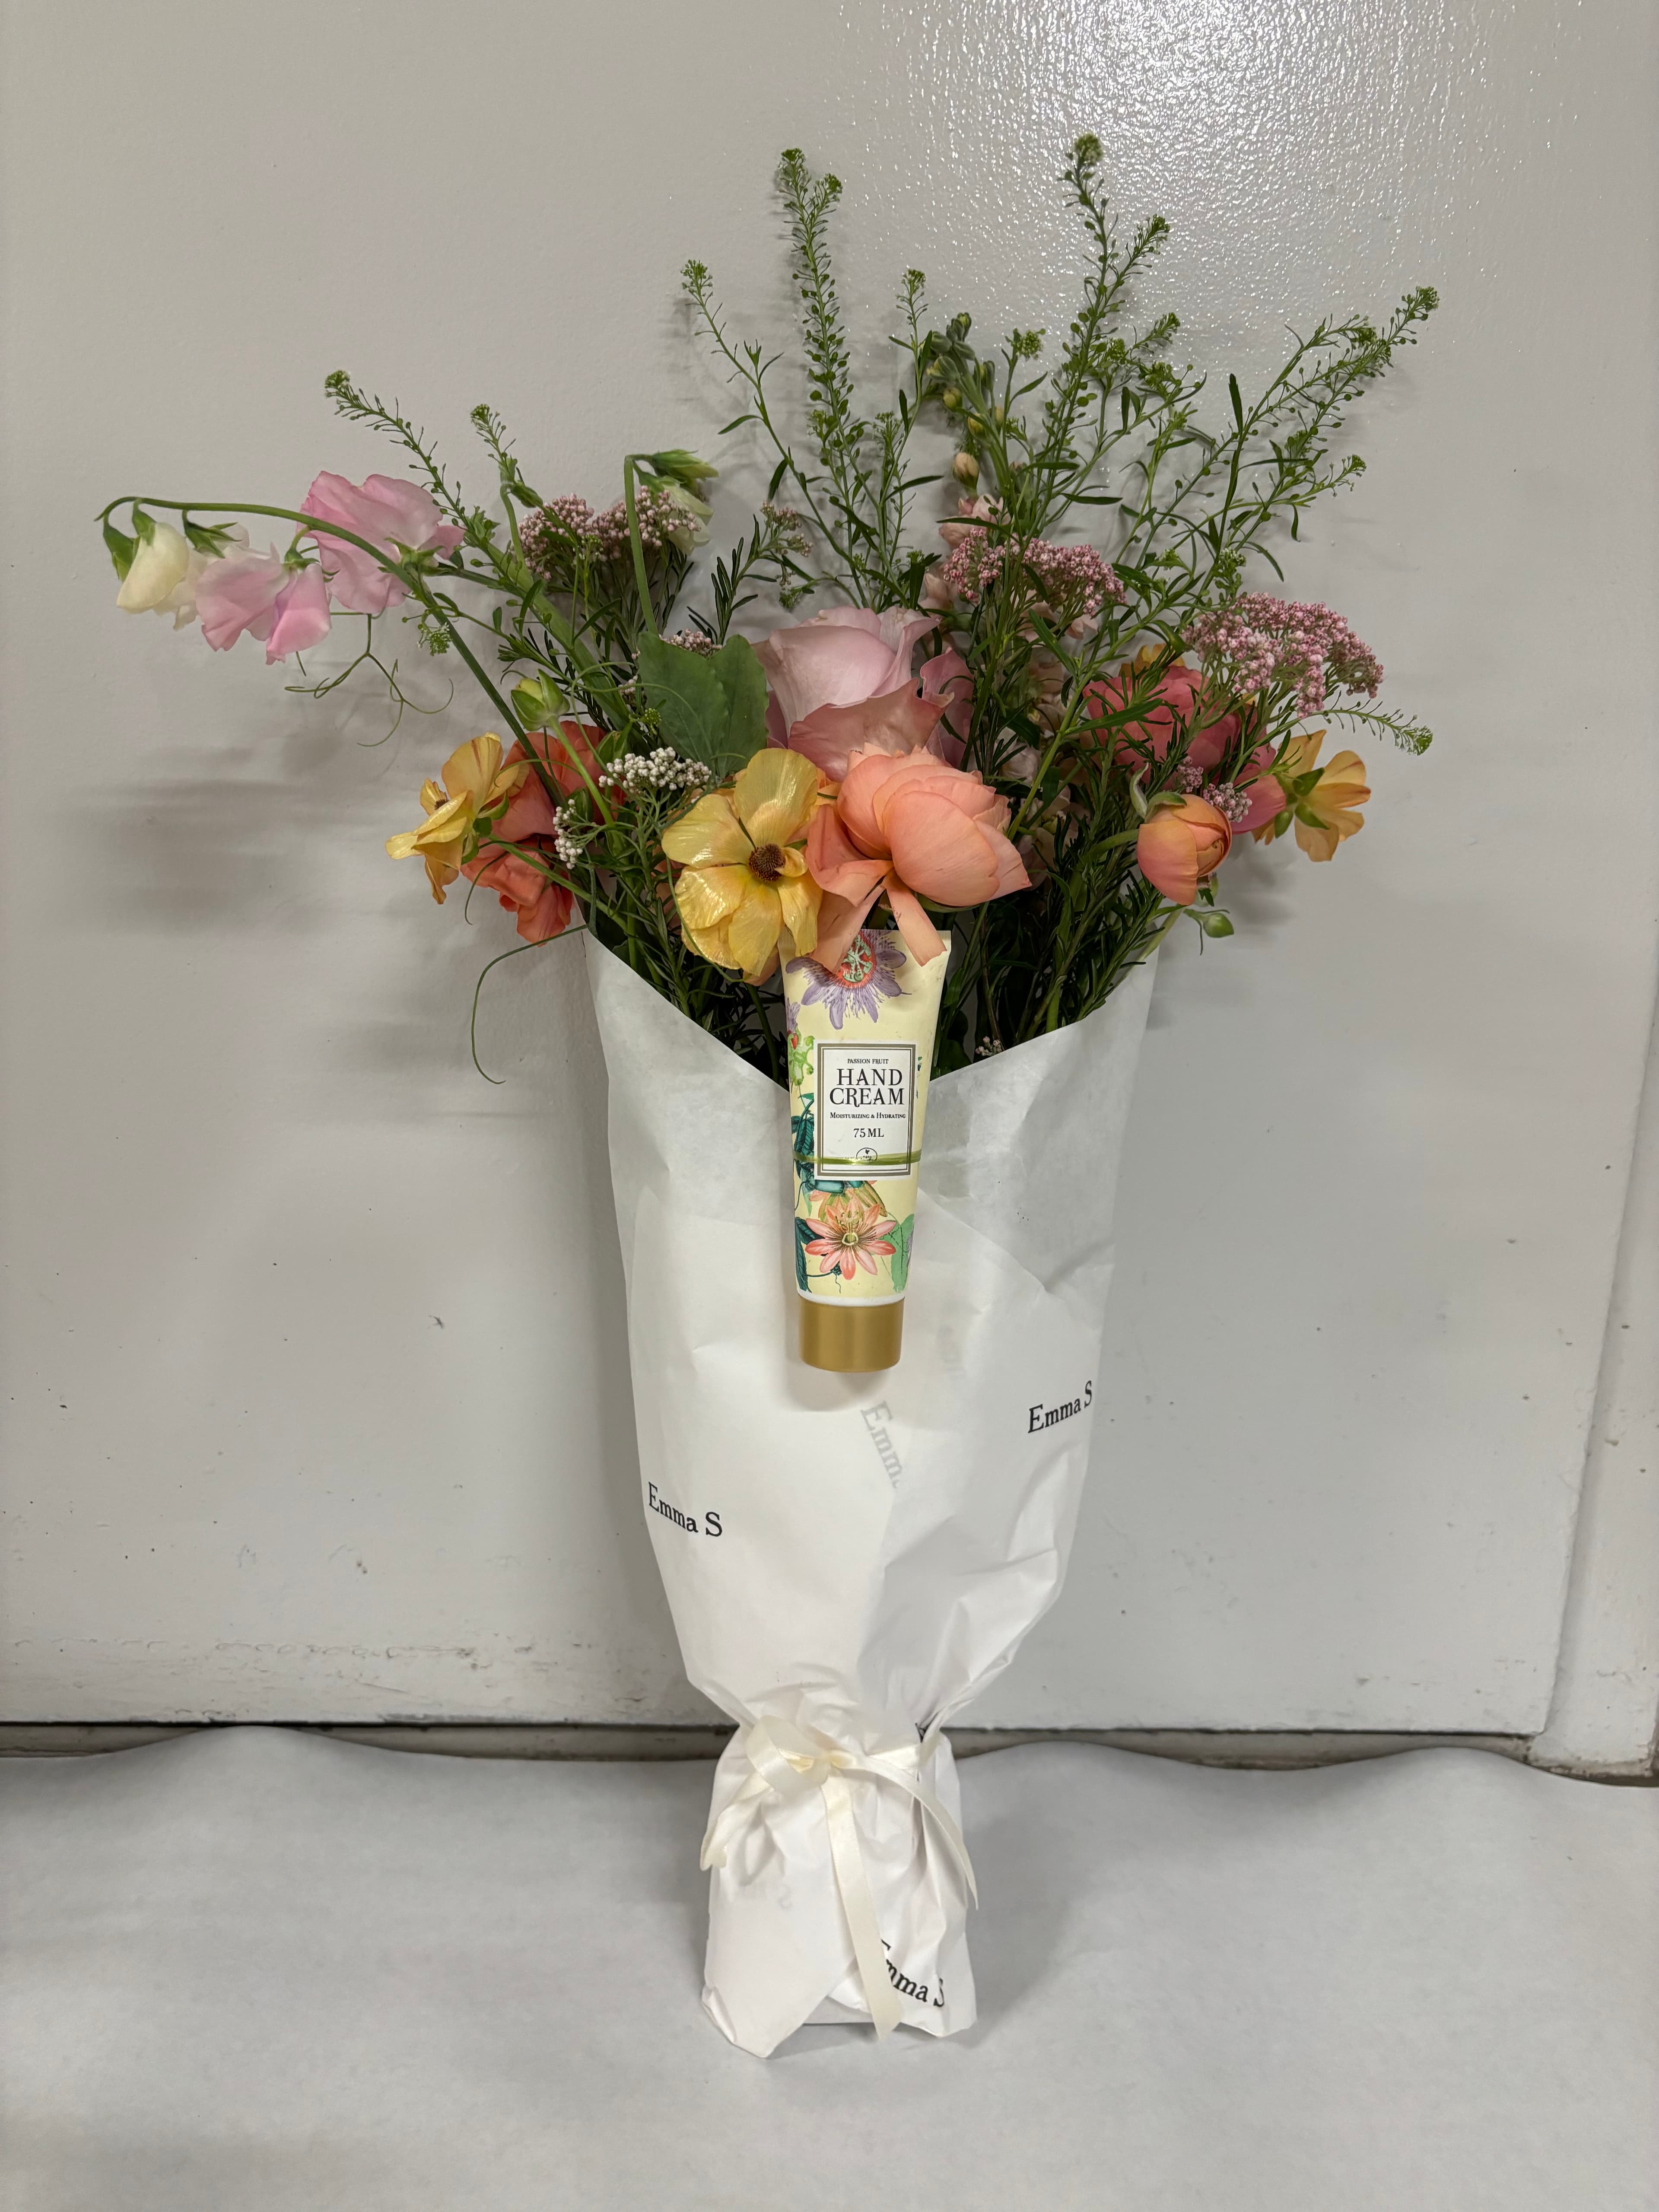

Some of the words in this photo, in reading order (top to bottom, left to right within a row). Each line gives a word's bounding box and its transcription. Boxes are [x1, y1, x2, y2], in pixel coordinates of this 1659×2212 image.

[830, 1087, 905, 1107] CREAM
[836, 1068, 903, 1086] HAND
[1028, 1398, 1081, 1433] Emma
[1084, 1380, 1092, 1408] S
[648, 1481, 699, 1533] Emma
[706, 1512, 722, 1537] S
[881, 1939, 928, 2002] mma
